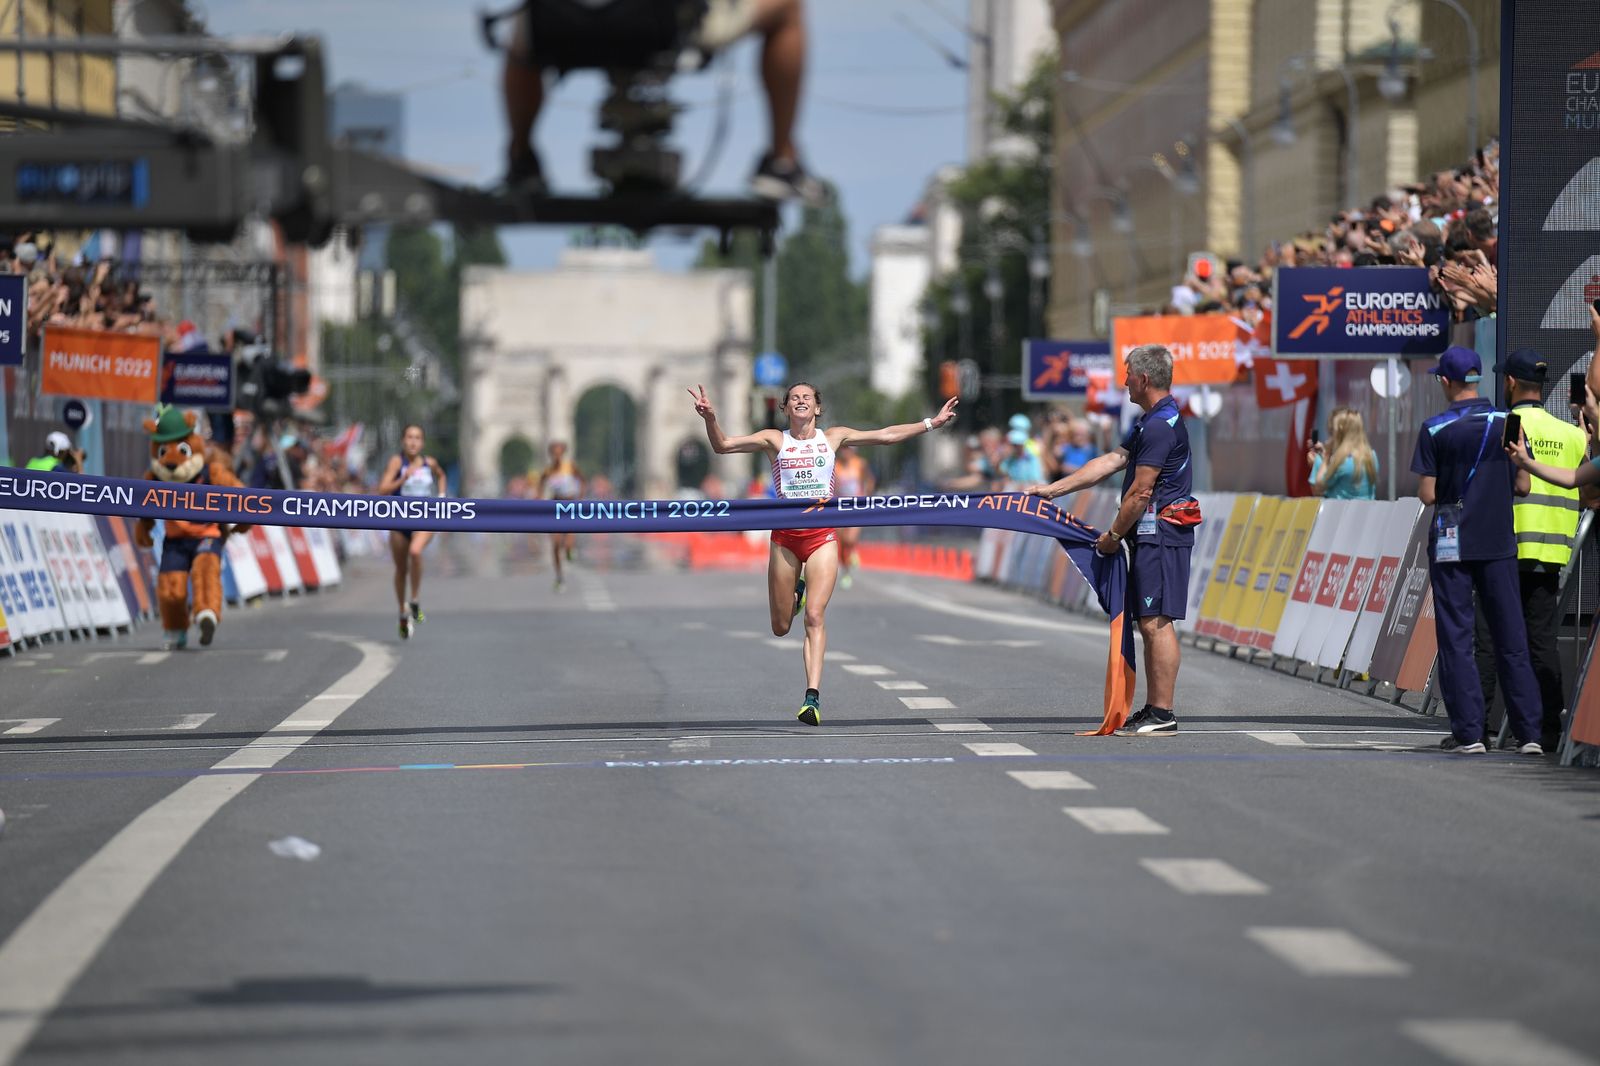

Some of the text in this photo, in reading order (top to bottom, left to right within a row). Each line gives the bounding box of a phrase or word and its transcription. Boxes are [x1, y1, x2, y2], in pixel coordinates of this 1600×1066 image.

[1345, 292, 1440, 310] EUROPEAN
[1345, 309, 1424, 324] ATHLETICS
[1345, 323, 1440, 337] CHAMPIONSHIPS
[50, 350, 153, 378] MUNICH 2022
[1534, 438, 1564, 450] KÖTTER
[1534, 448, 1560, 457] Security
[781, 459, 814, 468] SPAR
[794, 470, 813, 479] 485
[0, 477, 476, 520] EUROPEAN ATHLETICS CHAMPIONSHIPS
[783, 490, 809, 498] MUNICH
[837, 494, 970, 511] EUROPEAN
[555, 500, 731, 520] MUNICH 2022
